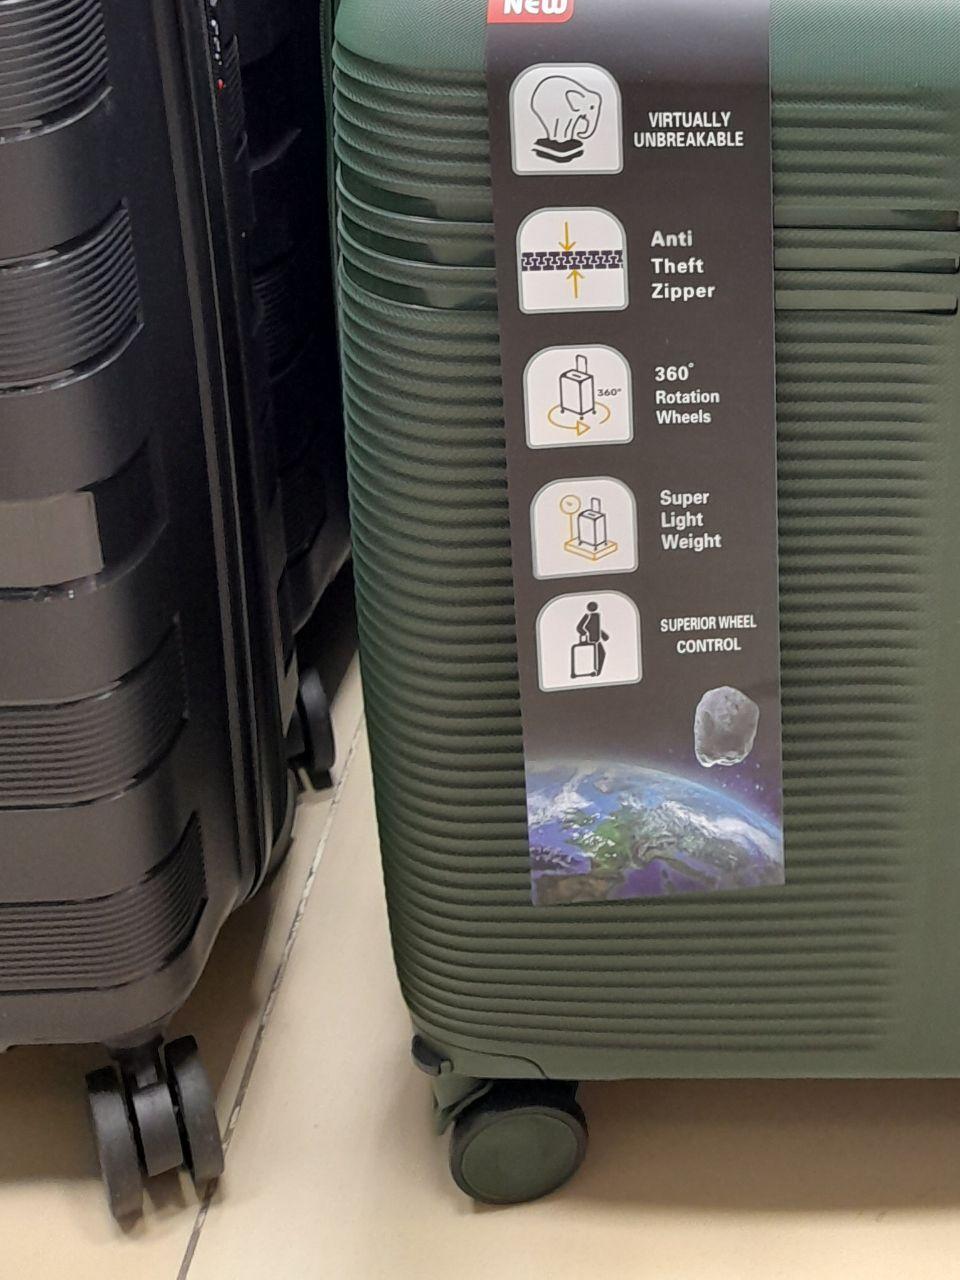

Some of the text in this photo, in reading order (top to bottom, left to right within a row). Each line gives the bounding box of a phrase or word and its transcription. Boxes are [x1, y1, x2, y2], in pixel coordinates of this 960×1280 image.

[648, 111, 731, 128] VIRTUALLY
[633, 131, 744, 147] UNBREAKABLE
[650, 230, 693, 247] Anti
[651, 258, 704, 274] Theft
[651, 283, 715, 301] Zipper
[655, 389, 720, 404] Rotation
[656, 409, 711, 424] Wheels
[660, 490, 709, 508] Super
[661, 512, 703, 530] Light
[661, 534, 721, 551] Weight
[660, 615, 757, 632] SUPERIOR WHEEL
[677, 638, 741, 653] CONTROL
